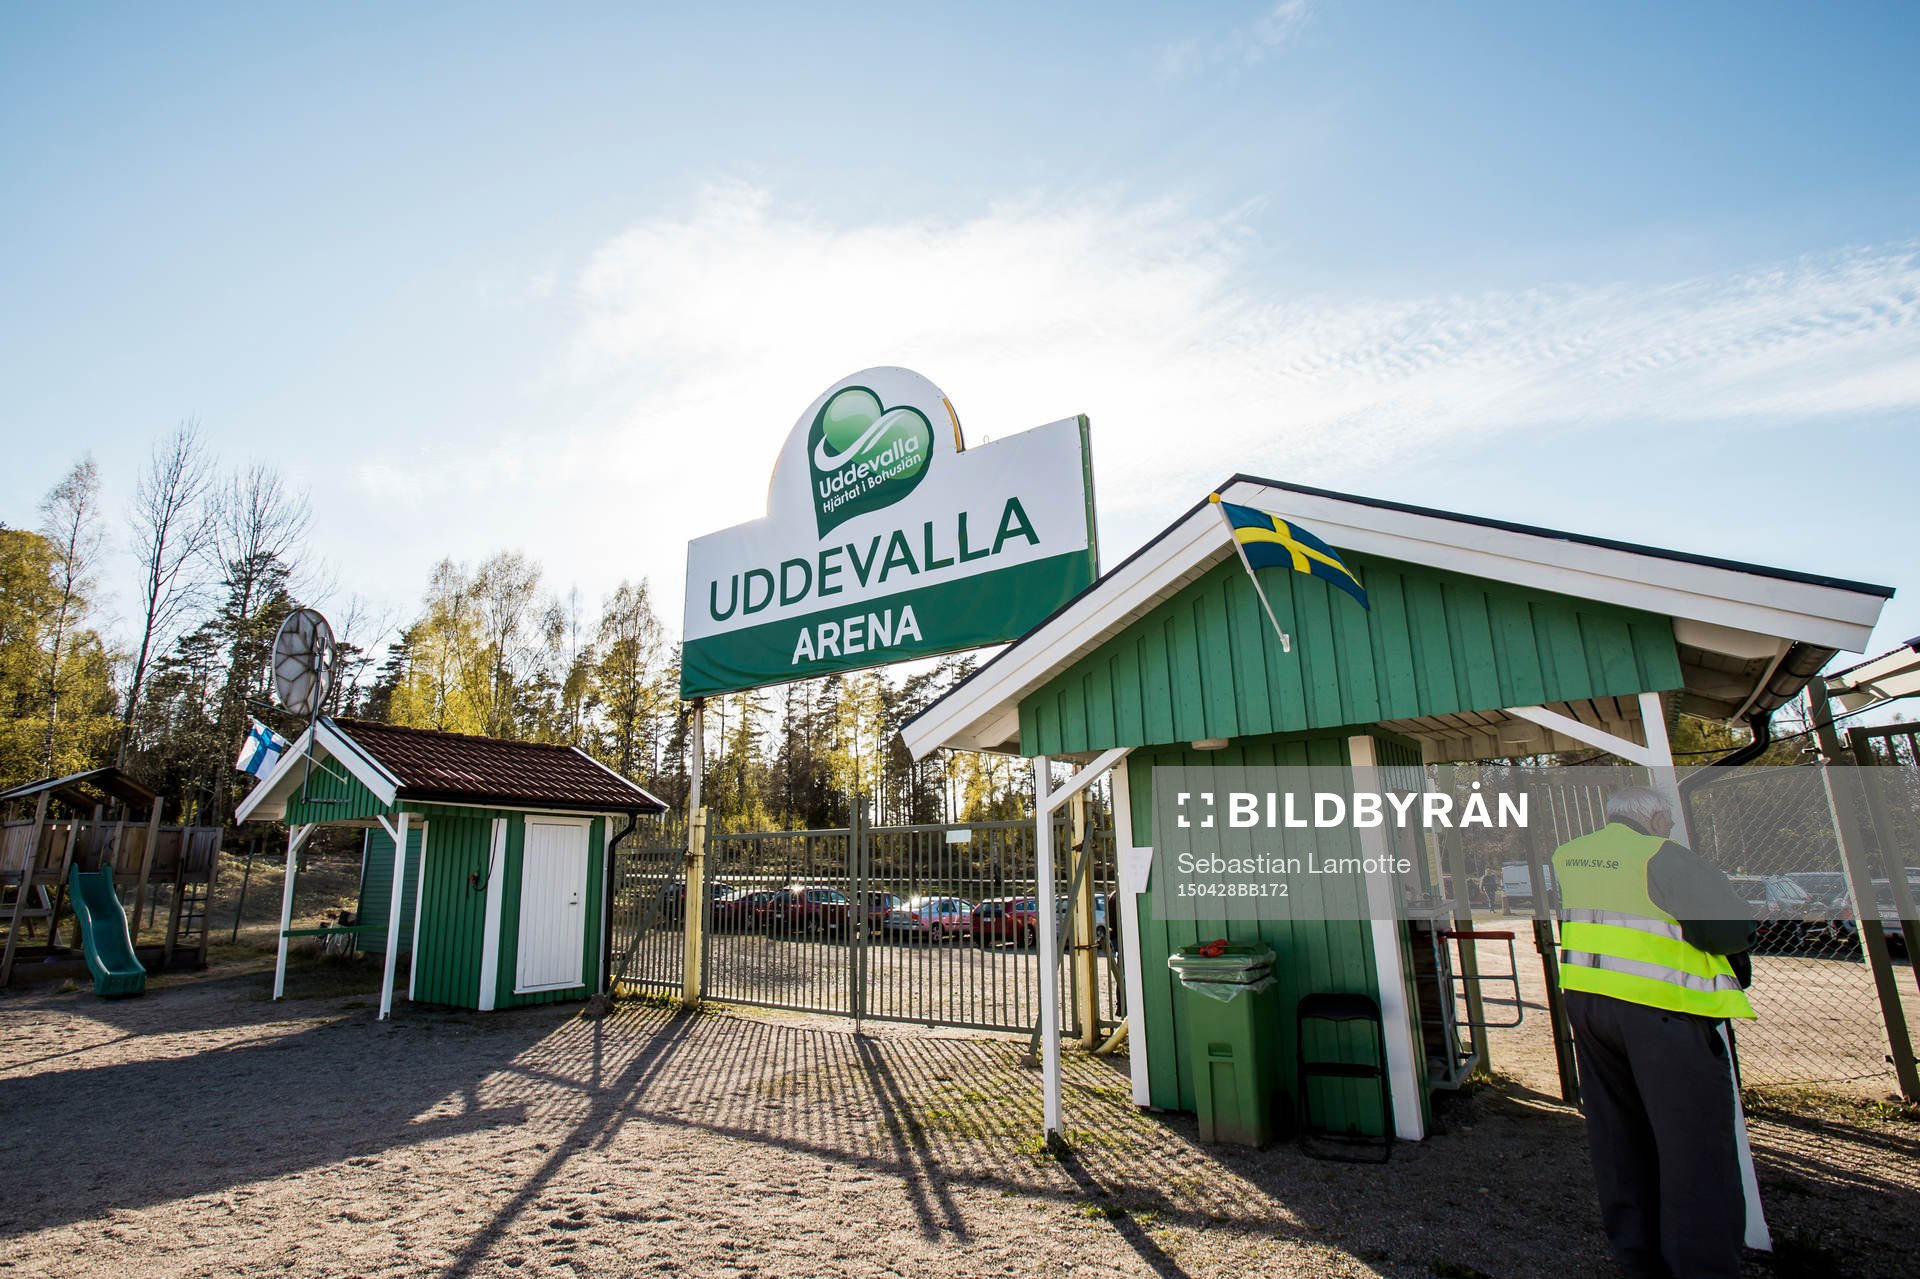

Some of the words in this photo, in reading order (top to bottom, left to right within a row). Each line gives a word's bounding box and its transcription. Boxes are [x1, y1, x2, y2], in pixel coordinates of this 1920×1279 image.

[819, 435, 919, 498] Uddevalla
[822, 484, 861, 513] Hjärtat
[861, 481, 867, 493] i
[867, 453, 922, 489] Bohuslän
[709, 496, 1040, 622] UDDEVALLA
[791, 605, 923, 665] ARENA
[1565, 858, 1619, 870] www.sv.se
